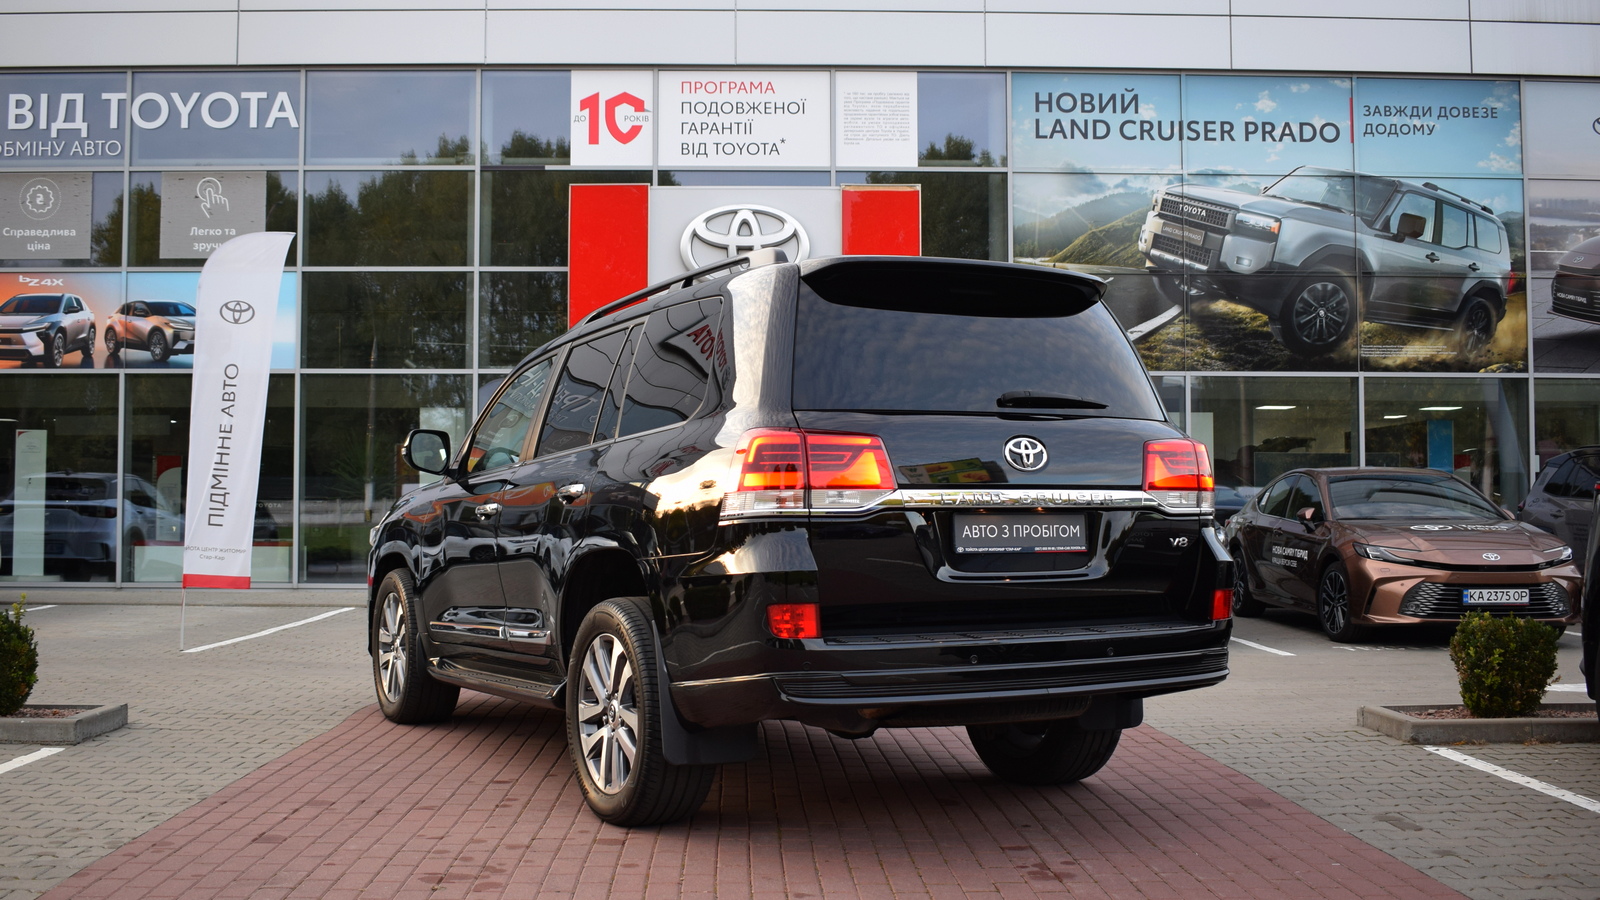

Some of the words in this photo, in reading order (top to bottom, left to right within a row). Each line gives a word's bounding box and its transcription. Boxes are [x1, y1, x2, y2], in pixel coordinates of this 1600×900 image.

[680, 81, 776, 95] ПРОГРАМА
[1034, 87, 1139, 114] НОВИЙ
[7, 92, 88, 138] ВІД
[101, 91, 300, 130] TOYOTA
[680, 99, 807, 117] ПОДОВЖЕНОЇ
[1363, 105, 1433, 119] ЗАВЖДИ
[1437, 106, 1498, 120] ДОВЕЗЕ
[574, 115, 587, 123] ДО
[624, 114, 650, 123] РОКІВ
[680, 119, 754, 135] ГАРАНТІЇ
[1034, 118, 1111, 140] LAND
[1119, 119, 1236, 142] CRUISER
[1245, 121, 1341, 143] PRADO
[1363, 123, 1436, 137] ДОДОМУ
[70, 140, 122, 156] АВТО
[680, 142, 708, 158] ВІД
[1179, 204, 1206, 216] TOYOTA
[2, 227, 76, 238] Справедлива
[190, 227, 222, 238] Легко
[224, 228, 236, 237] та
[27, 240, 51, 252] ціна
[208, 424, 233, 527] ПІДМІННЕ
[221, 363, 239, 418] АВТО
[940, 492, 1002, 505] LAND
[1021, 492, 1114, 505] CRUISER
[962, 524, 998, 538] АВТО
[1001, 524, 1010, 538] З
[1013, 524, 1081, 538] ПРОБІГОМ
[1169, 537, 1188, 547] V8
[1469, 591, 1484, 601] KA
[1487, 591, 1511, 601] 2375
[1513, 591, 1528, 601] OP
